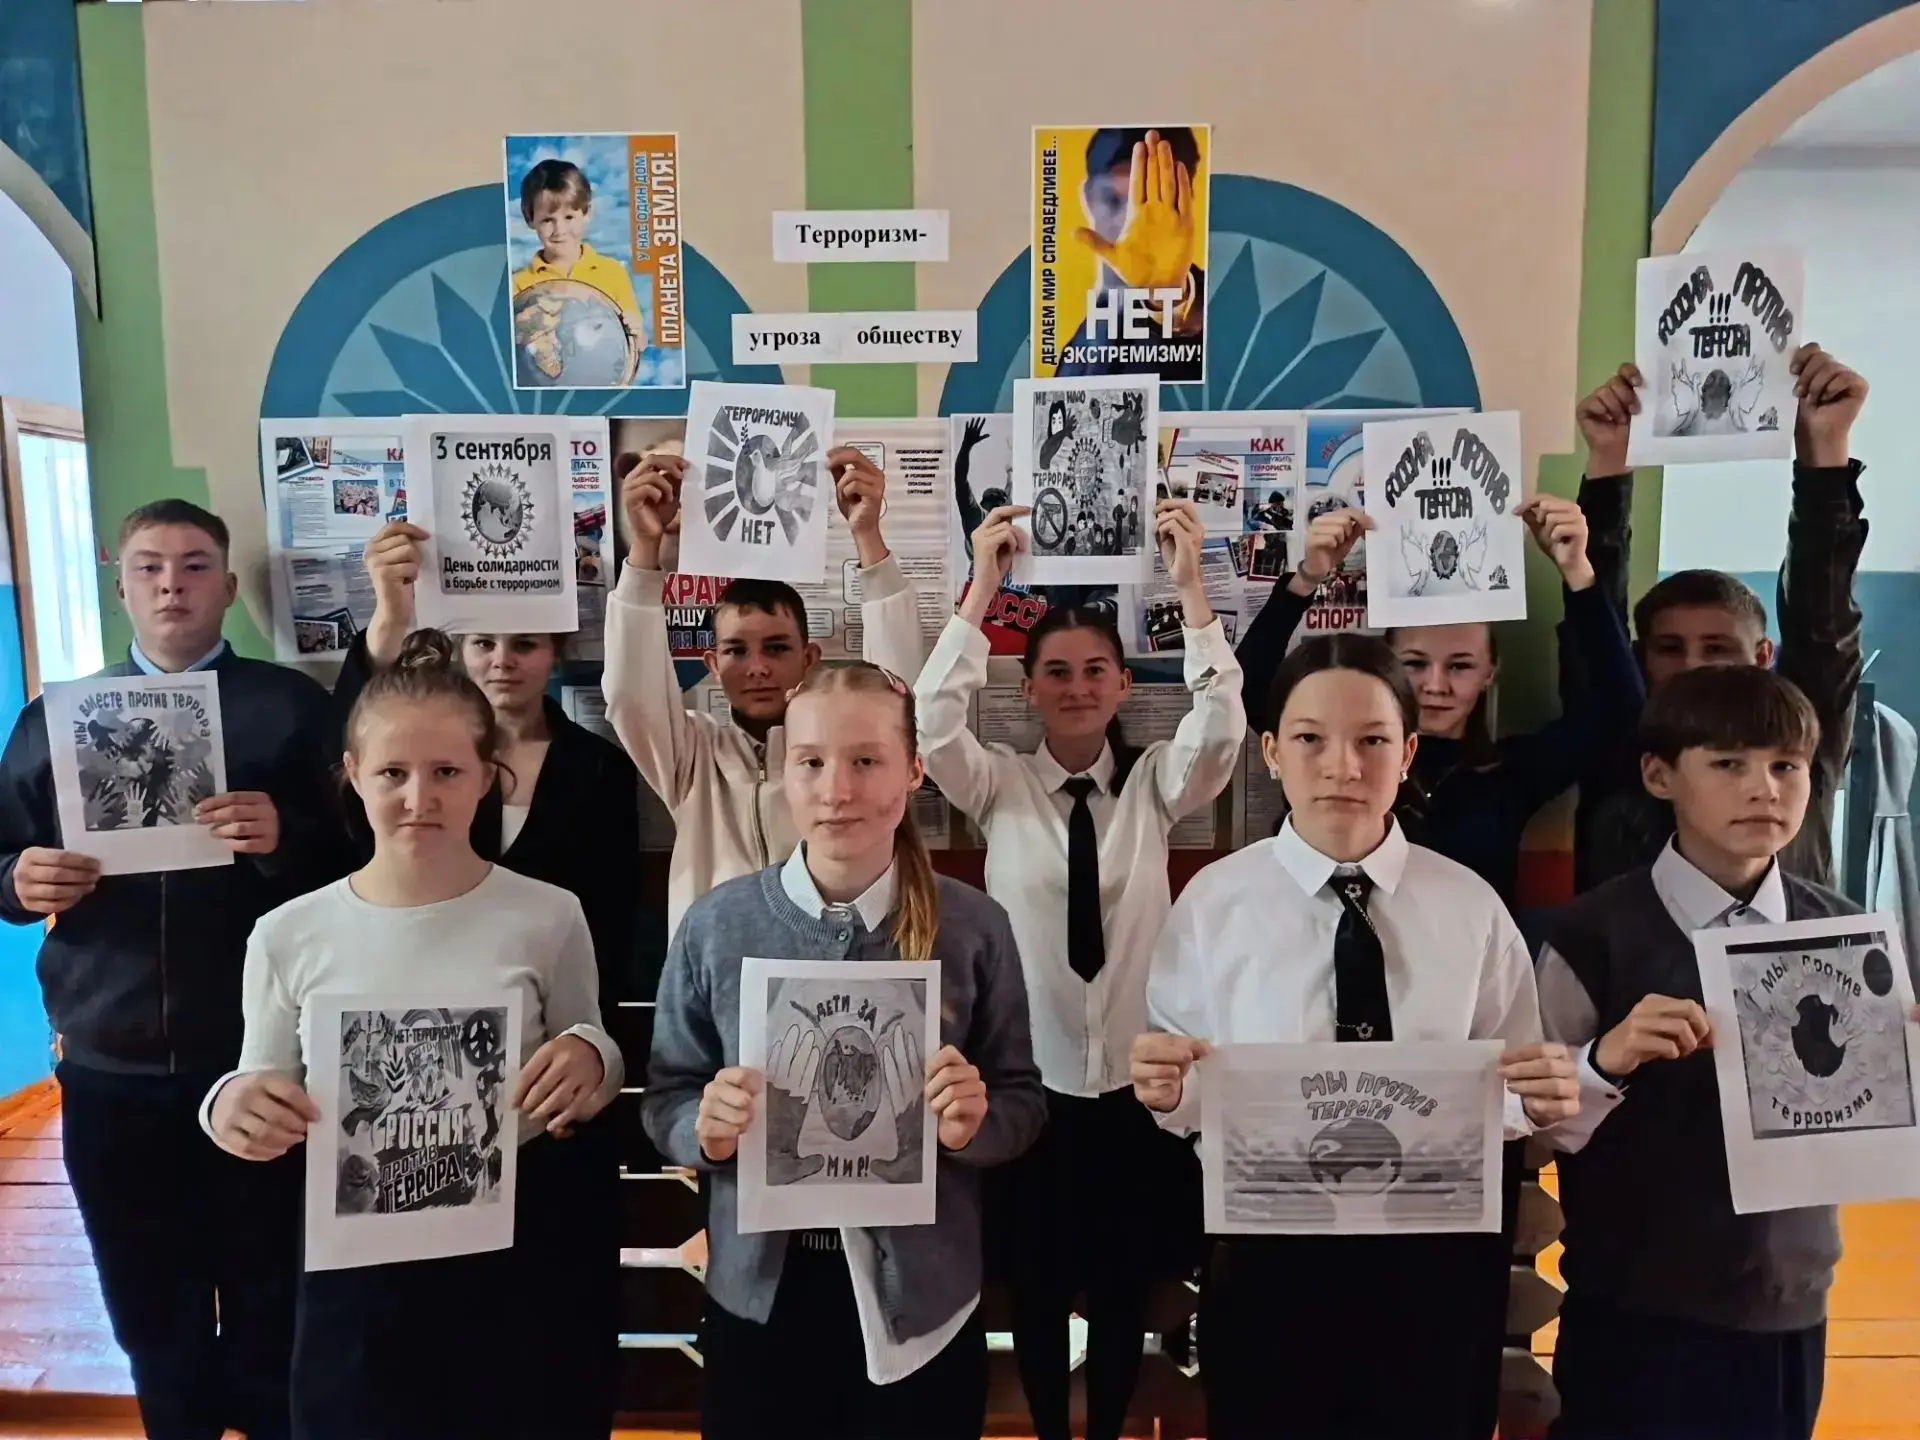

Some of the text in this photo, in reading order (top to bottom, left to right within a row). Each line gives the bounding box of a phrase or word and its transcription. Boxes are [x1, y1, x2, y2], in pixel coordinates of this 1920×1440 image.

[635, 186, 650, 221] ОДИН
[636, 222, 650, 247] НАС
[651, 152, 680, 344] ПЛАНЕТА ЗЕМЛЯ!
[795, 224, 928, 248] Терроризм-
[1042, 268, 1056, 303] МИР
[1086, 288, 1184, 340] НЕТ
[749, 326, 963, 352] угроза обществу
[1041, 308, 1058, 366] ДЕЛАЕМ
[1063, 344, 1201, 364] ЭКСТРЕМИЗМУ!
[725, 405, 801, 428] ТЕРРОРИЗМУ
[435, 435, 552, 467] 3 сентября
[1249, 438, 1285, 452] КАК
[741, 518, 775, 545] НЕТ
[443, 556, 560, 576] День солидарности
[445, 577, 560, 592] в борьбе с терроризмом
[1306, 607, 1365, 629] СПОРТ
[857, 999, 878, 1032] ЗА
[1301, 1070, 1438, 1117] МЫ ПРОТИВ
[1307, 1099, 1395, 1121] ТЕРРОРА
[384, 1107, 465, 1151] РОССИЯ
[382, 1144, 439, 1184] ПРОТИВ
[383, 1152, 463, 1214] ТЕРРОРА
